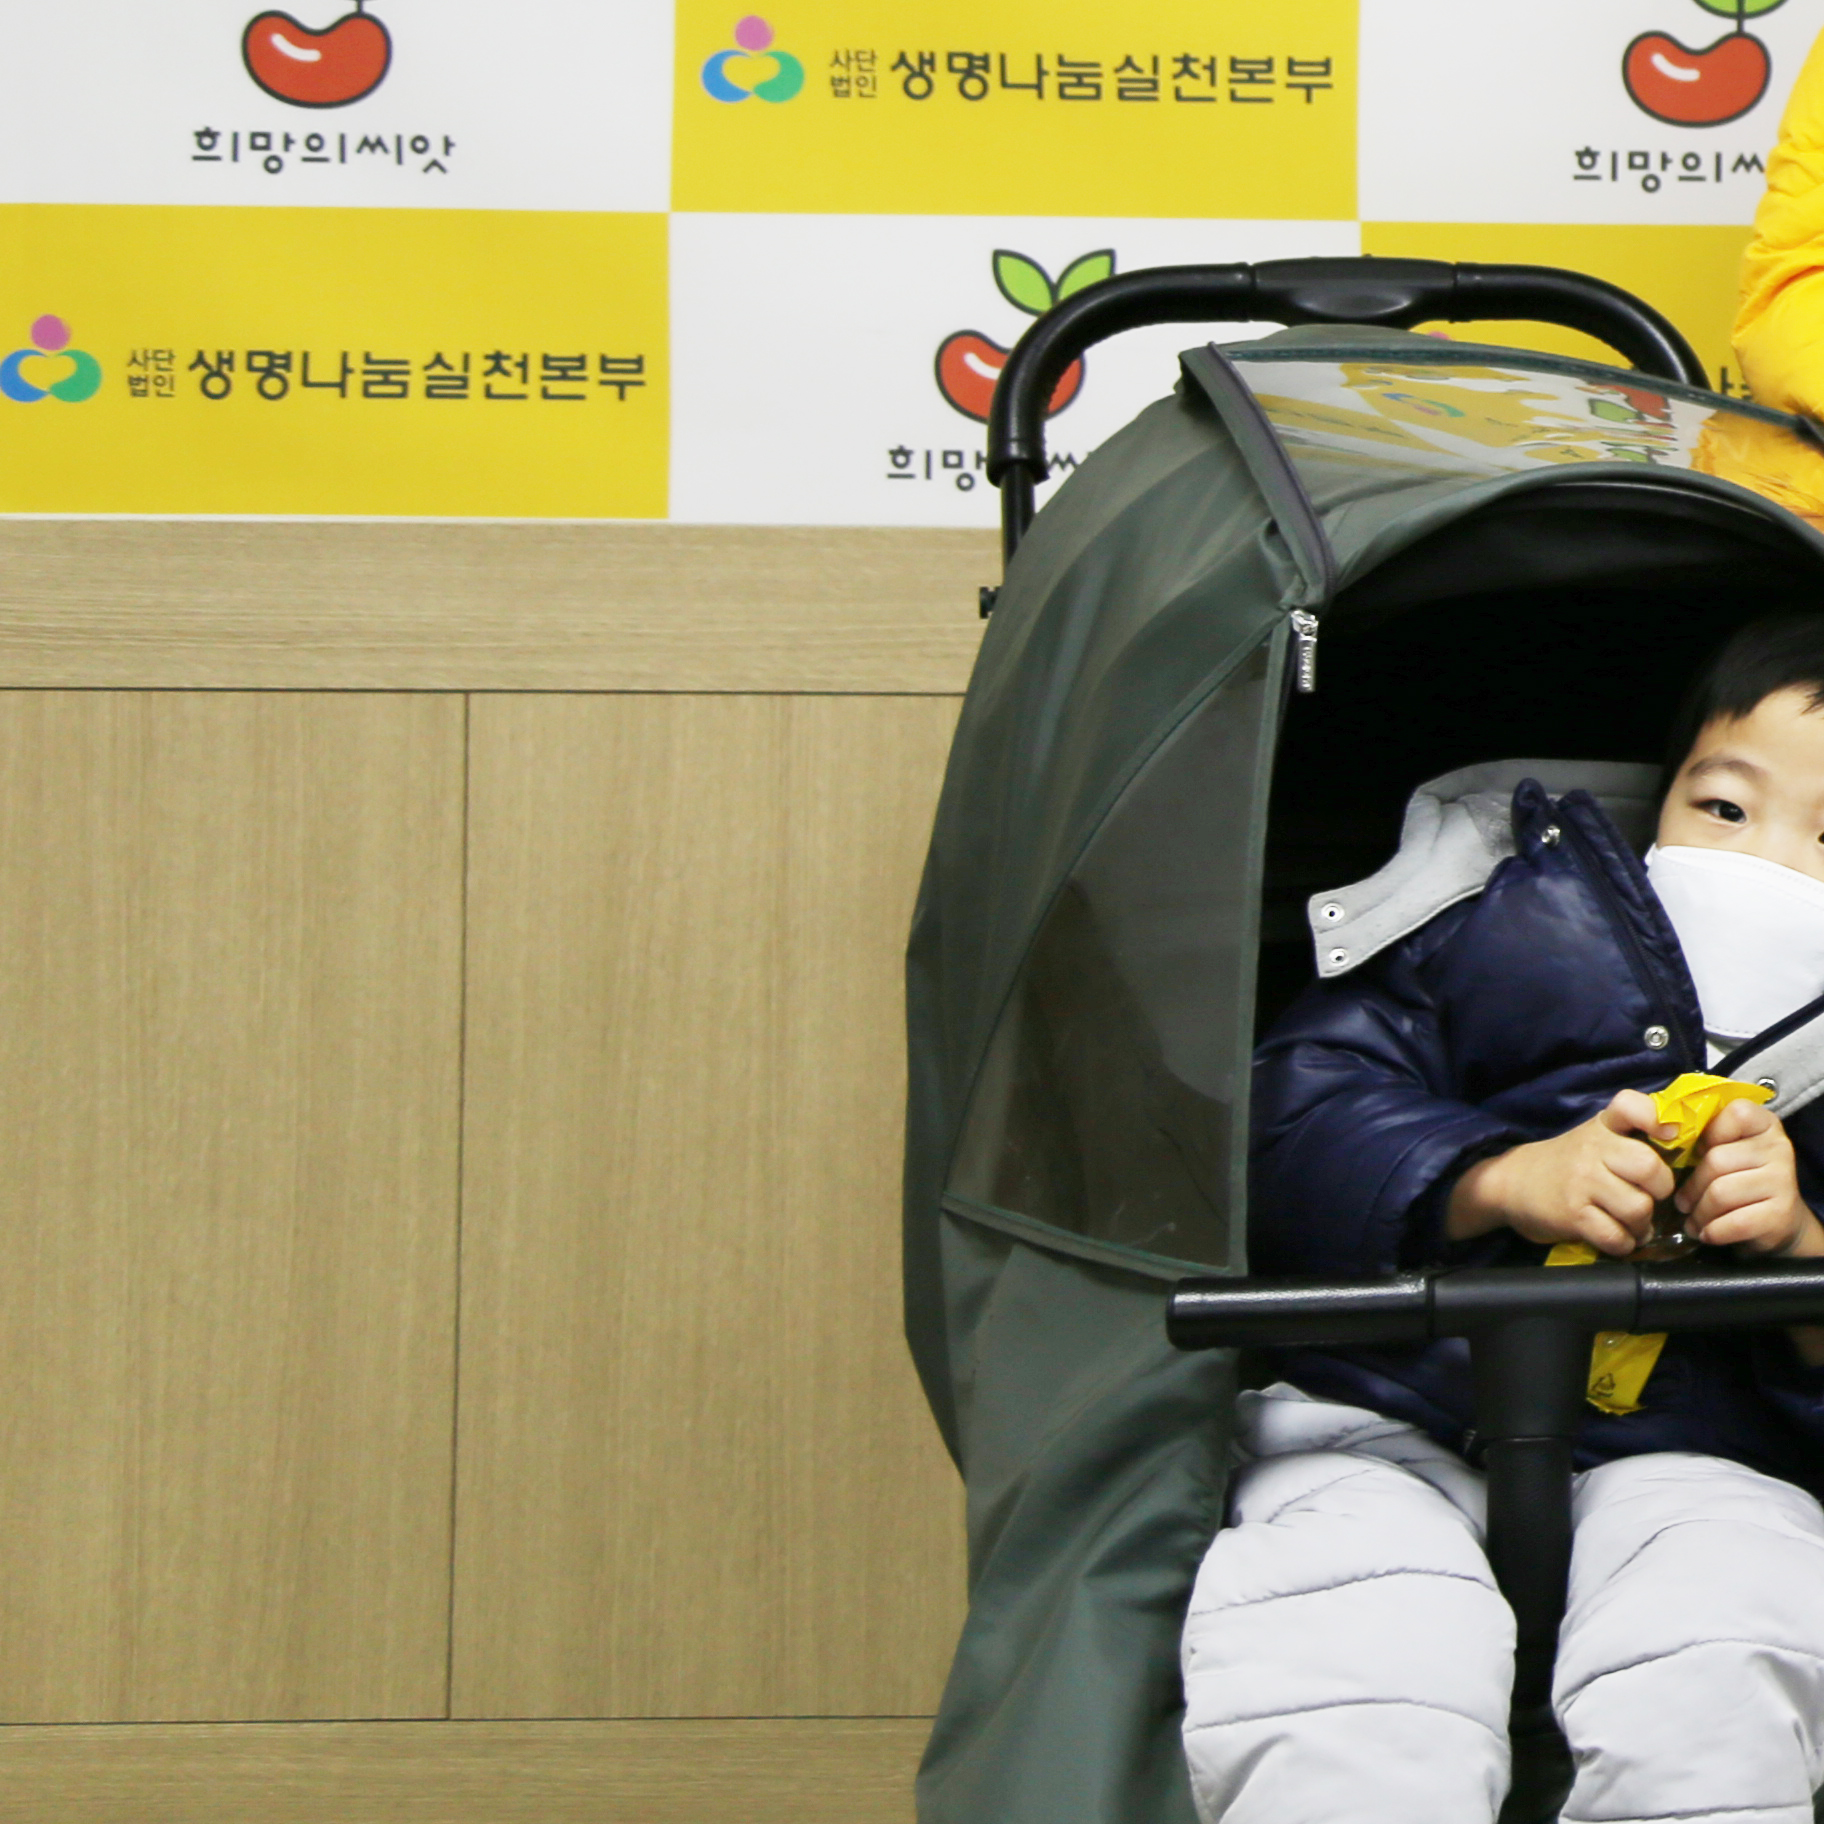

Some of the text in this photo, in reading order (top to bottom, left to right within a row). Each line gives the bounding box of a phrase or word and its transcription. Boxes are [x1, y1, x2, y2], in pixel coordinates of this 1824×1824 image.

[890, 51, 1333, 104] 생명나눔실천본부
[191, 126, 455, 175] 희망의씨앗
[187, 349, 646, 402] 생명나눔실천본부
